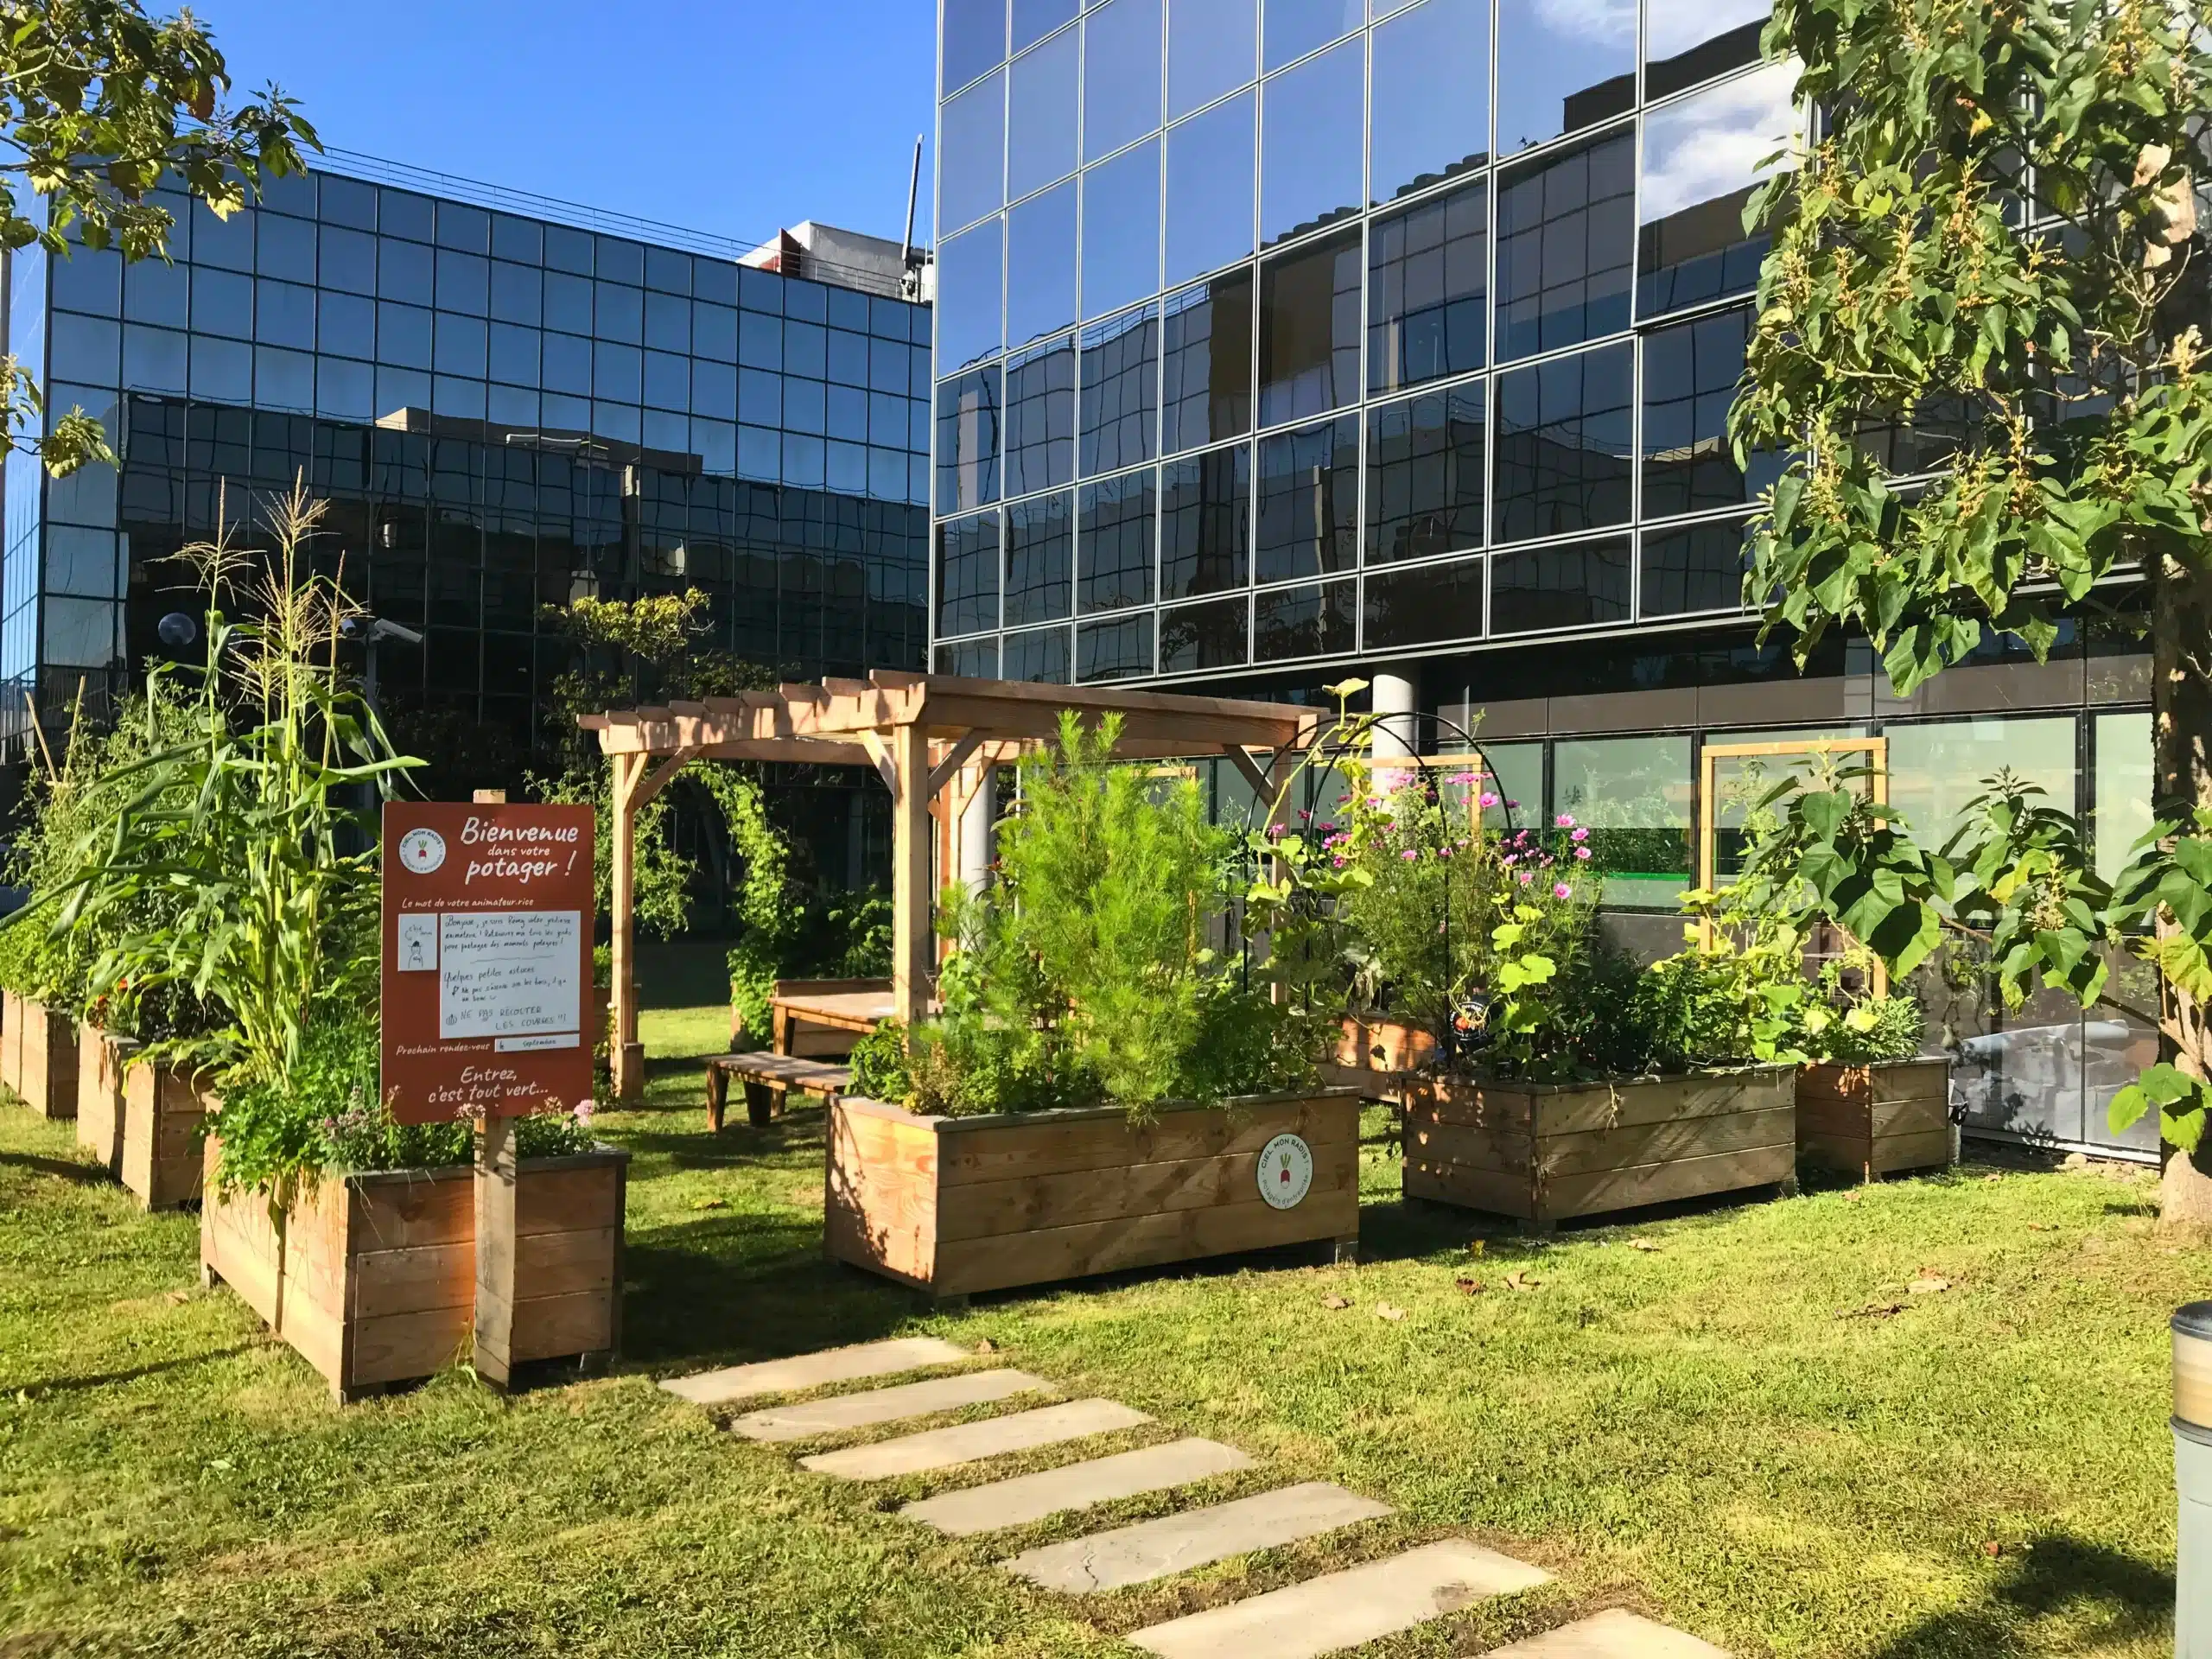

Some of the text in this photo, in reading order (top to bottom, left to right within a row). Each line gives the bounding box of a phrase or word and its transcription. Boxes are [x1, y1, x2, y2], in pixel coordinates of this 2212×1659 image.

[427, 832, 442, 845] RADIS
[461, 816, 579, 845] Bienvenue
[487, 843, 550, 856] dans votre
[465, 850, 576, 885] potager !
[402, 898, 534, 909] Le mot de votre animateur.rice
[444, 969, 474, 988] Quelques
[479, 967, 502, 982] petites
[461, 1009, 473, 1020] NE
[479, 1008, 493, 1017] PAS
[495, 1020, 514, 1030] LES
[521, 1016, 554, 1027] COURGES
[397, 1042, 490, 1056] Prochain rendez-vous
[461, 1065, 517, 1084] Entrez,
[428, 1082, 549, 1103] c'est tout vert...
[1274, 1138, 1290, 1148] MON
[1291, 1139, 1309, 1160] RADIS
[1262, 1174, 1309, 1205] potagers d'entreprise
